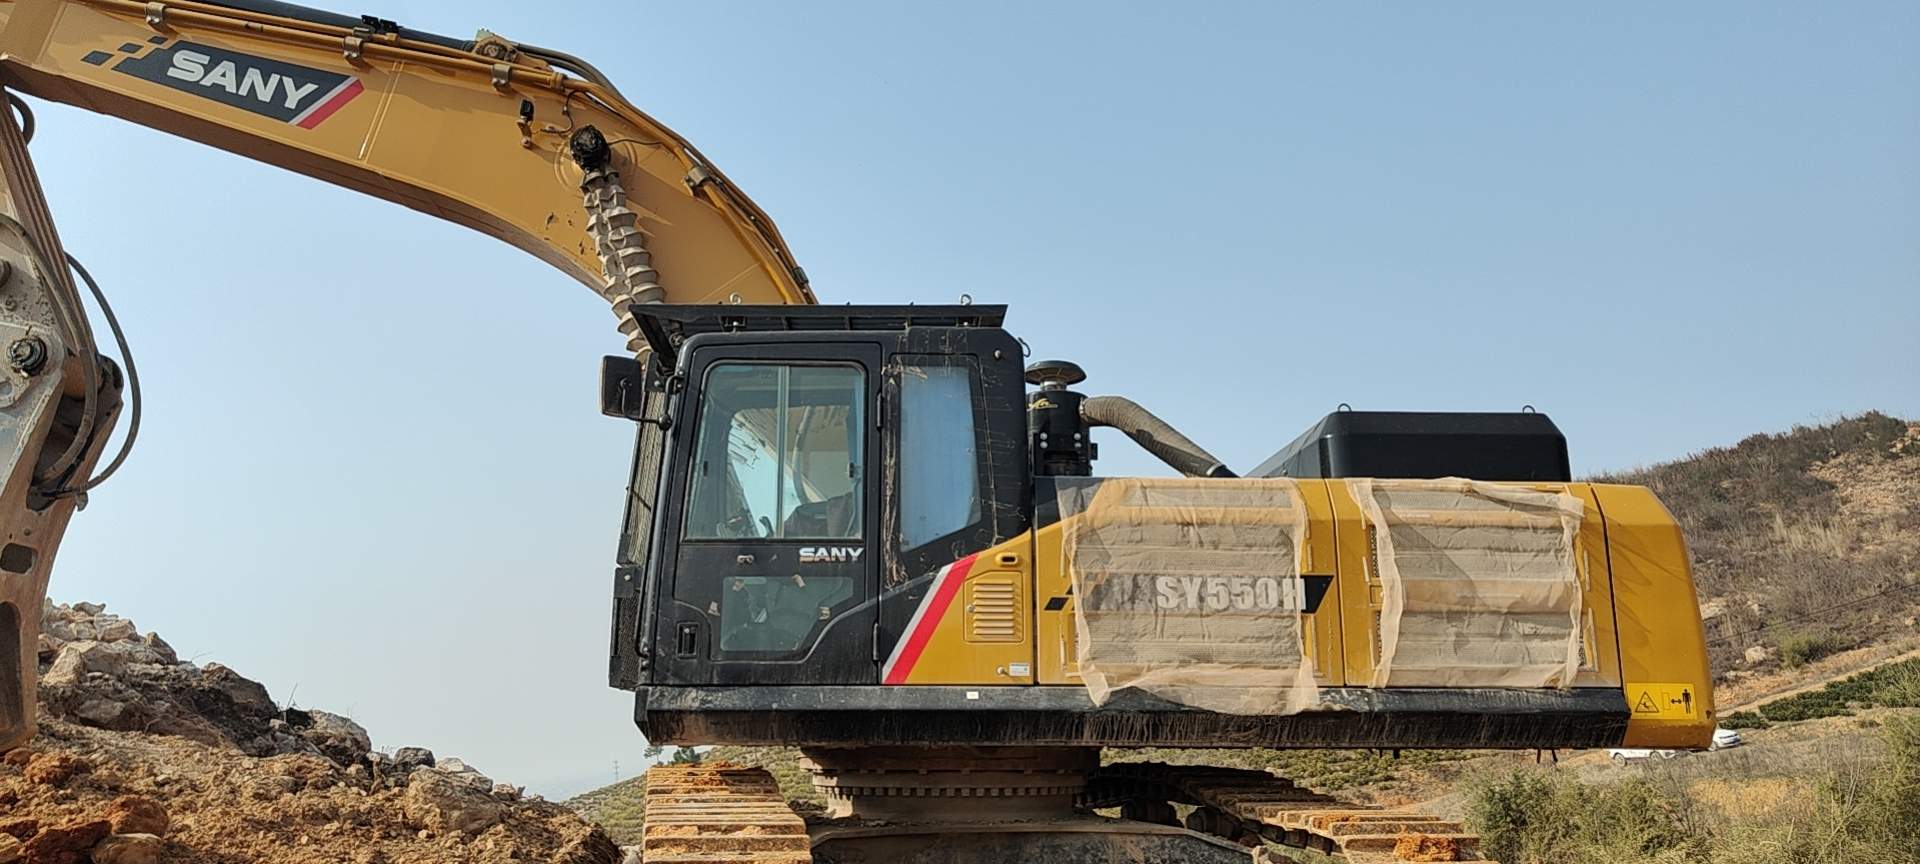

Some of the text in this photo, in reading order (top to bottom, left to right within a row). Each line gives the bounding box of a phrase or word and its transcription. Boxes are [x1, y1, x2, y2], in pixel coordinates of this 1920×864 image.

[167, 50, 319, 110] SANY
[799, 547, 864, 561] SANY
[1156, 576, 1306, 610] SY550H
